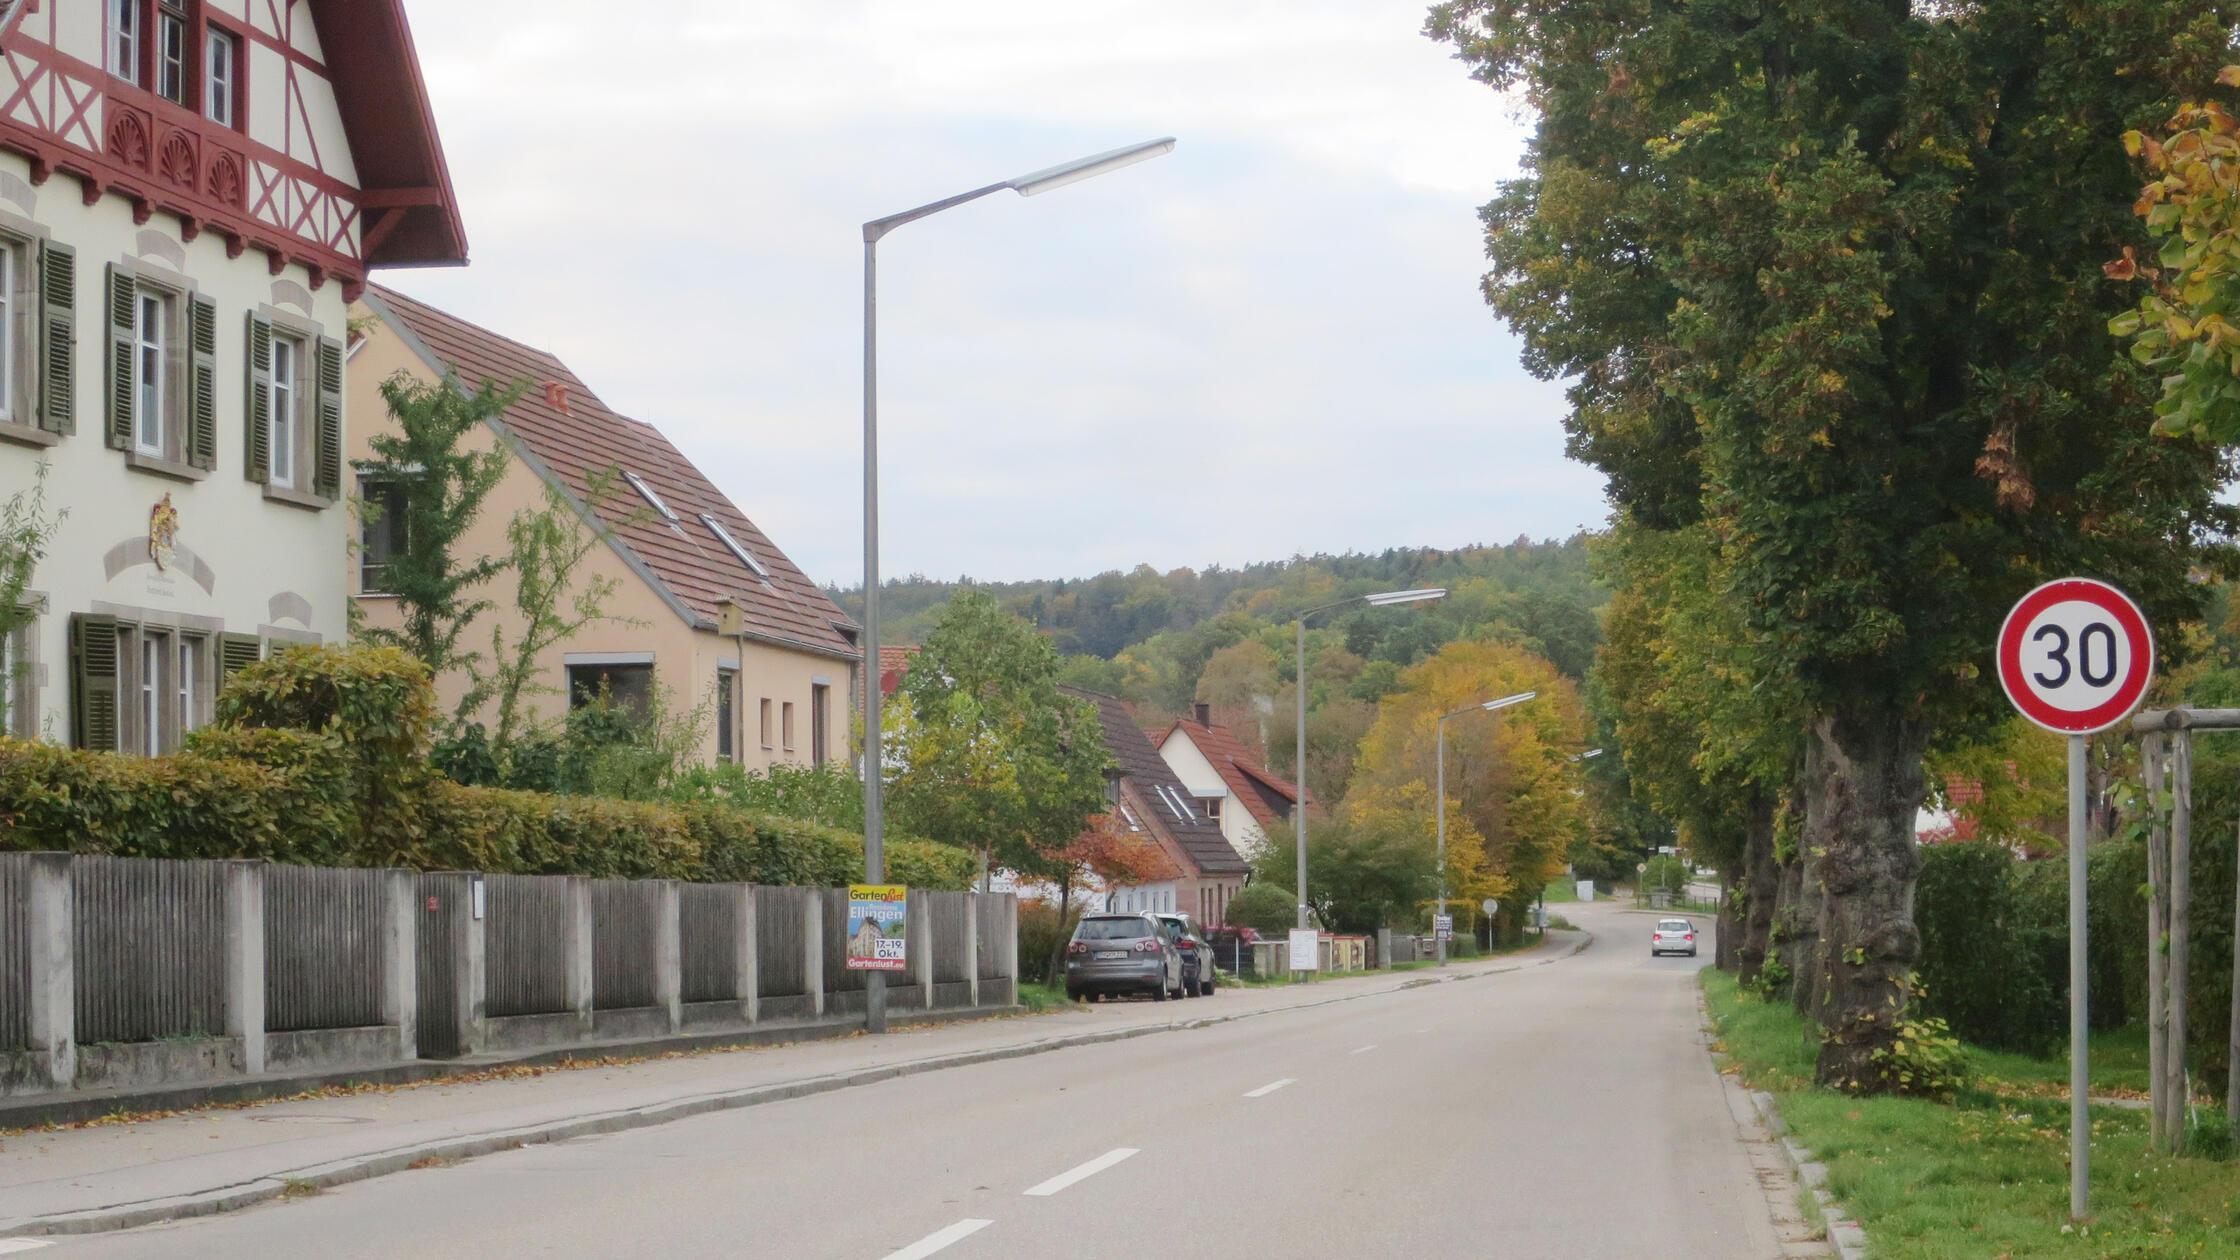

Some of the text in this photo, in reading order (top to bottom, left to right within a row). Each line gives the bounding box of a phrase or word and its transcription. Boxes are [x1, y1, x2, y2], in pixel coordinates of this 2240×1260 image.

[2033, 622, 2117, 689] 30
[850, 906, 903, 922] Ellingen
[878, 949, 899, 958] Okt.
